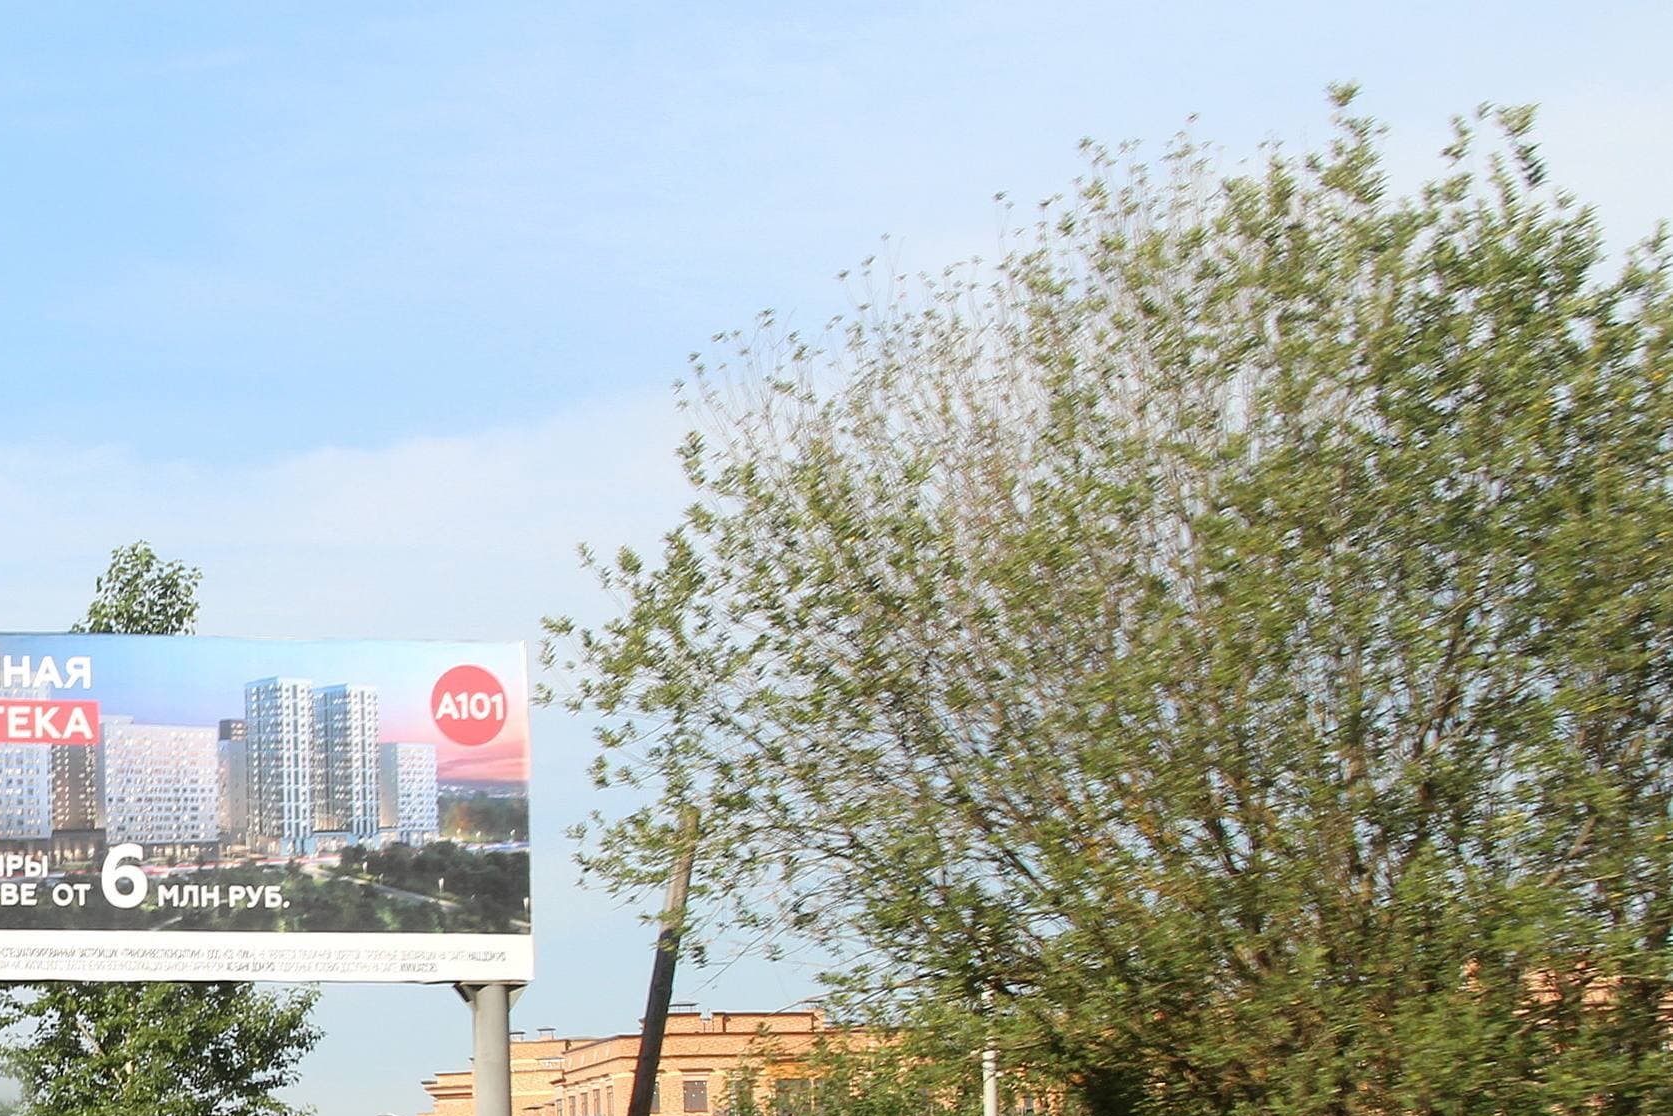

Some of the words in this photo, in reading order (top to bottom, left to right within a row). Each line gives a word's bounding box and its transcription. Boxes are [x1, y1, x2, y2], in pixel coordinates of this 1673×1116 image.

[435, 691, 504, 720] А101
[52, 884, 91, 907] ОТ
[101, 843, 149, 909] 6
[158, 884, 221, 908] МЛН
[228, 886, 291, 909] РУБ.
